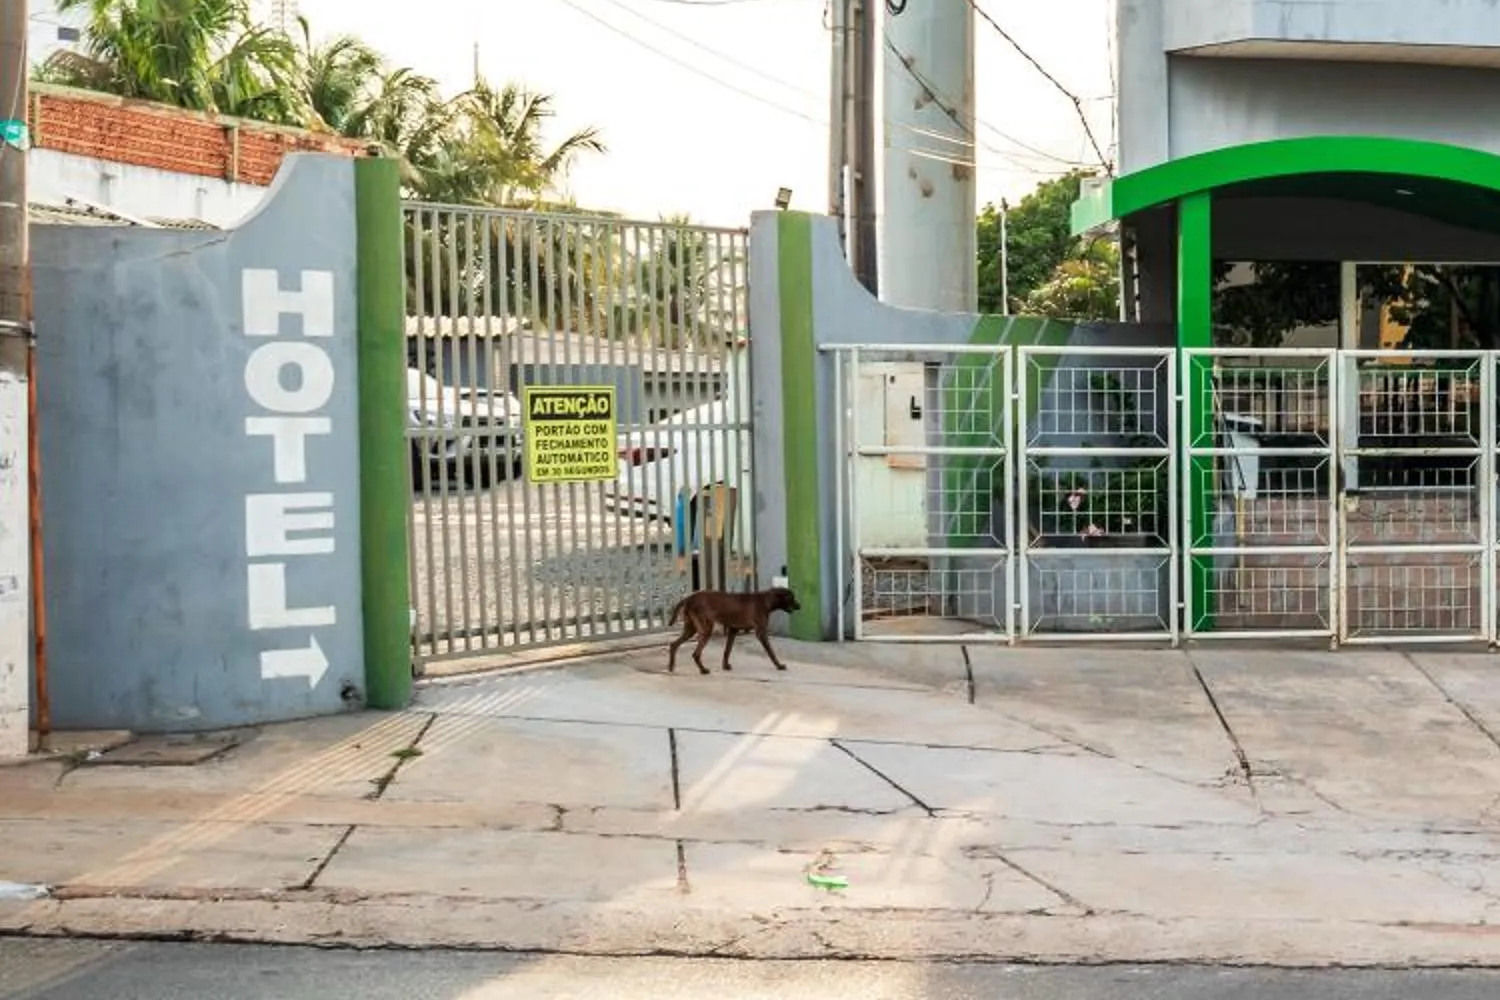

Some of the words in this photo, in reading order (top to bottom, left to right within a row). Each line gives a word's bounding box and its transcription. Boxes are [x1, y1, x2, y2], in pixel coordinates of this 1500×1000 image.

[533, 394, 609, 418] ATENÇÃO
[583, 424, 607, 435] COM
[241, 268, 336, 630] HOTEL
[535, 438, 609, 451] FECHAMENTO
